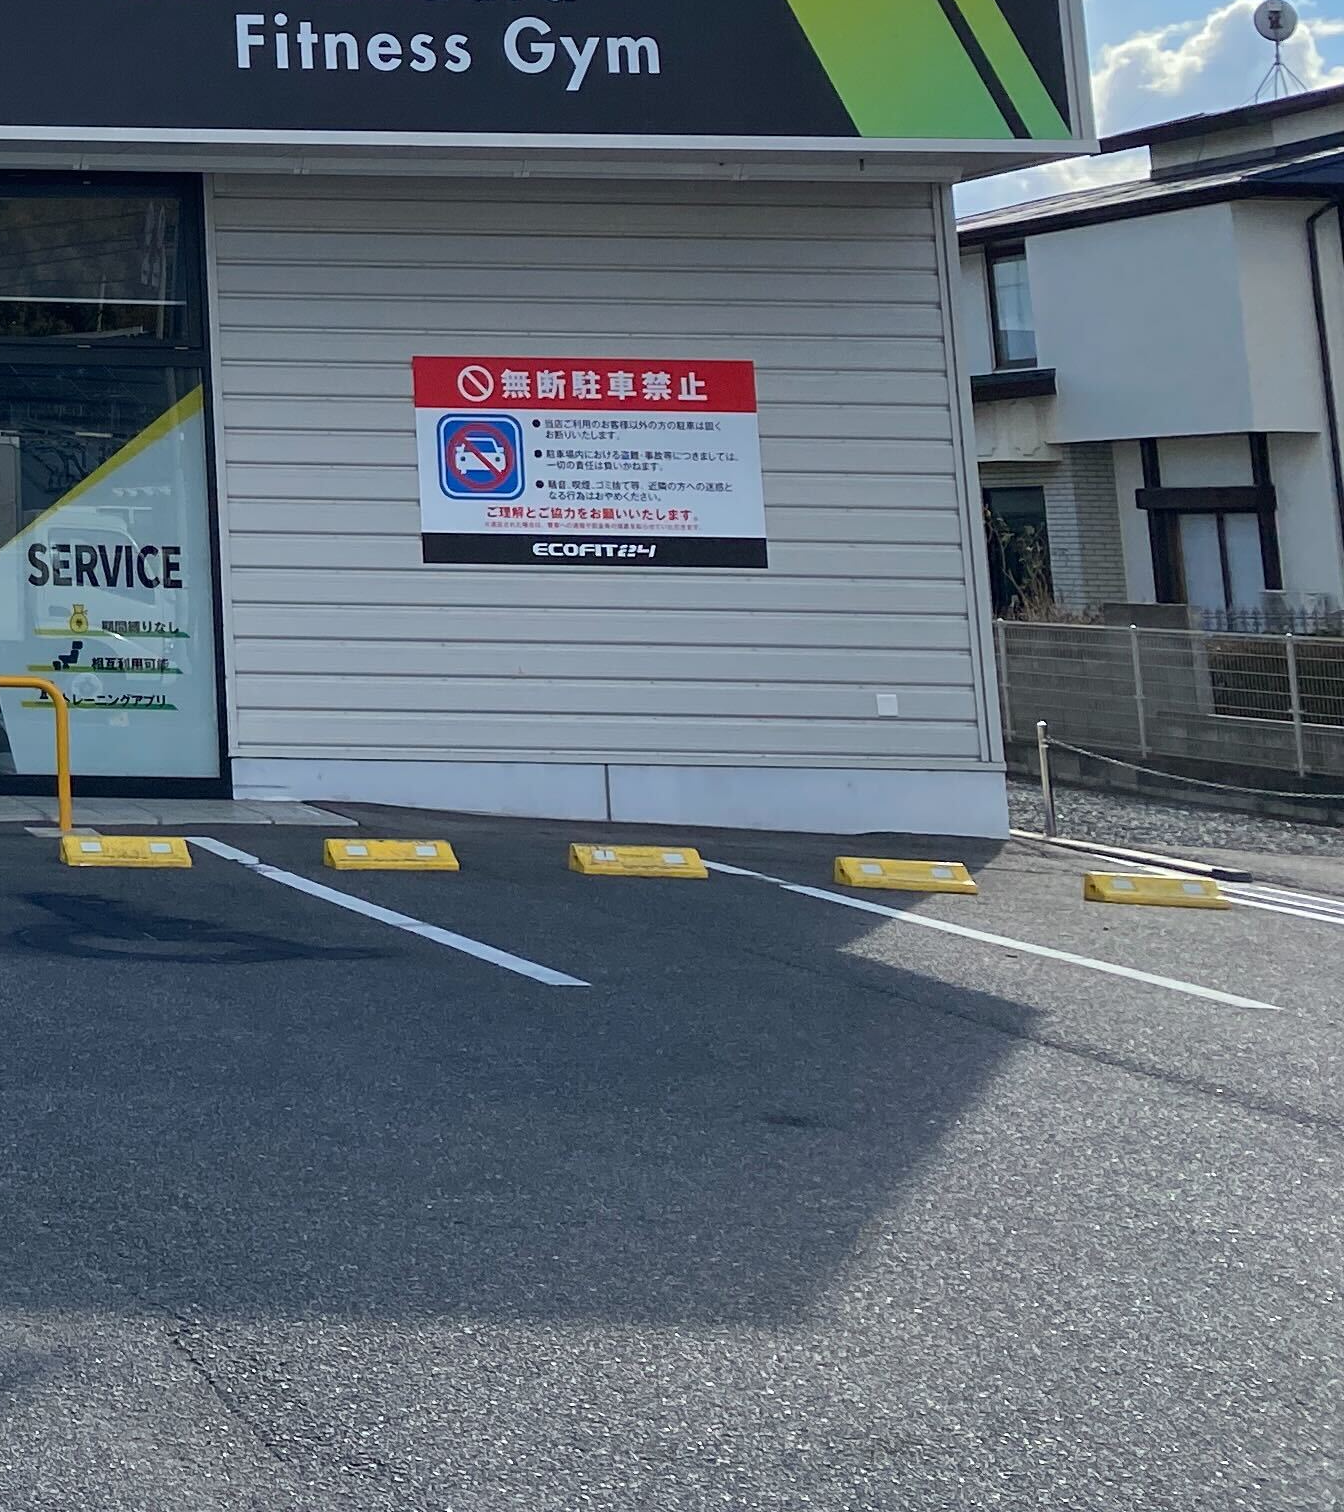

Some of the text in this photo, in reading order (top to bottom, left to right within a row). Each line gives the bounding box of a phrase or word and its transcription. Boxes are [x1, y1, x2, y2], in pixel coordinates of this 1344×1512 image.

[235, 12, 662, 91] Fitness Gym
[500, 368, 708, 402] 無断駐車禁止
[27, 543, 183, 589] SERVICE
[532, 543, 657, 558] ECOFIT24
